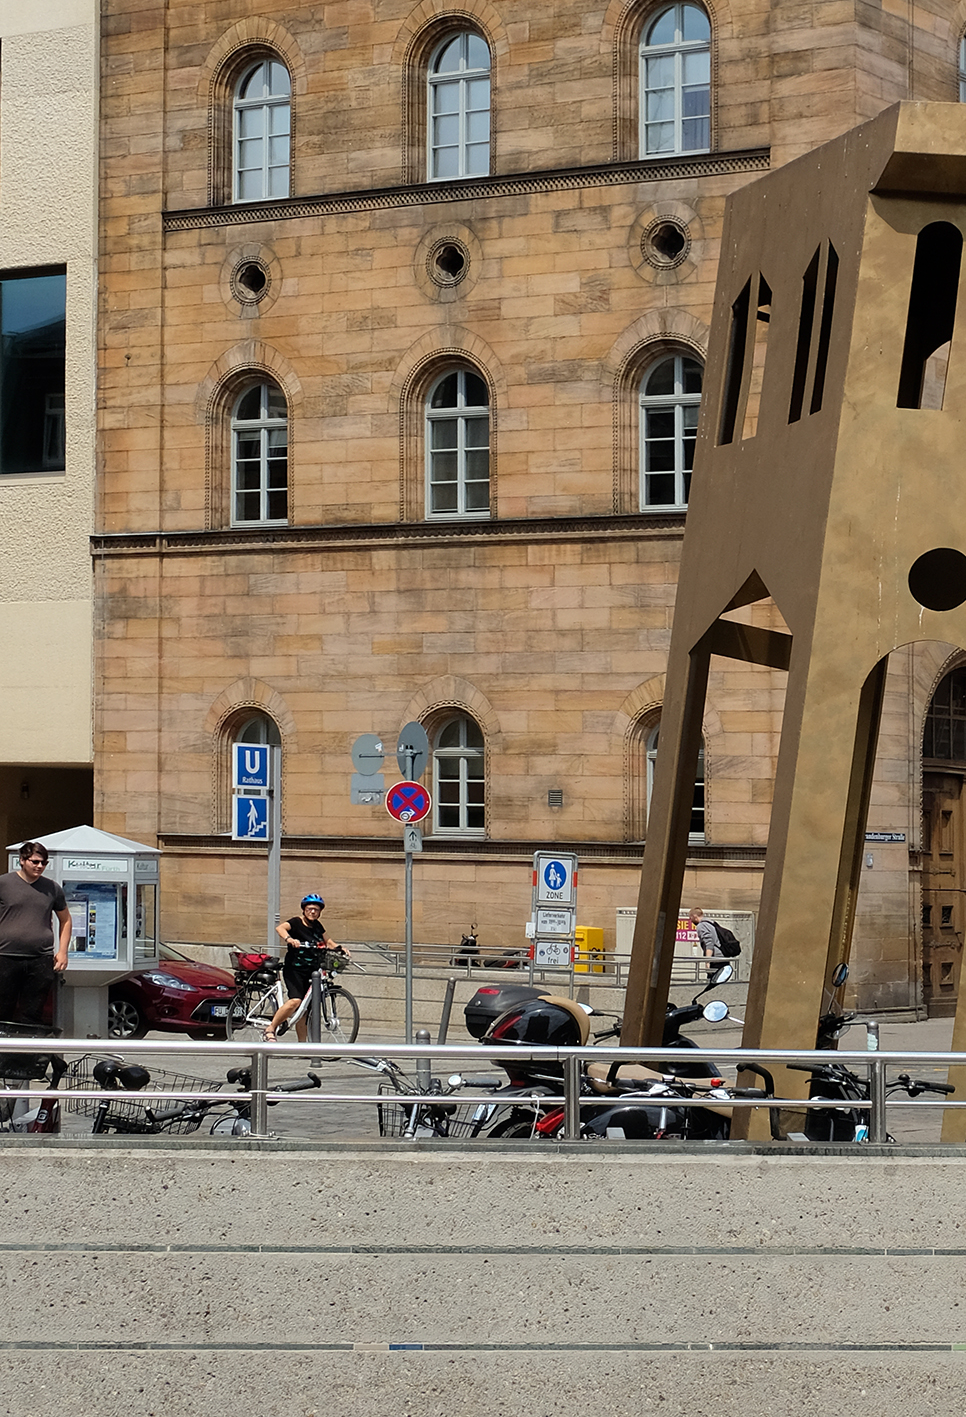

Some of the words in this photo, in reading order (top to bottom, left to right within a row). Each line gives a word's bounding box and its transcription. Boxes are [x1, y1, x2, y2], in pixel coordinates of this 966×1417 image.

[245, 749, 260, 774] U
[242, 776, 263, 784] Rathaus
[546, 891, 563, 899] ZONE
